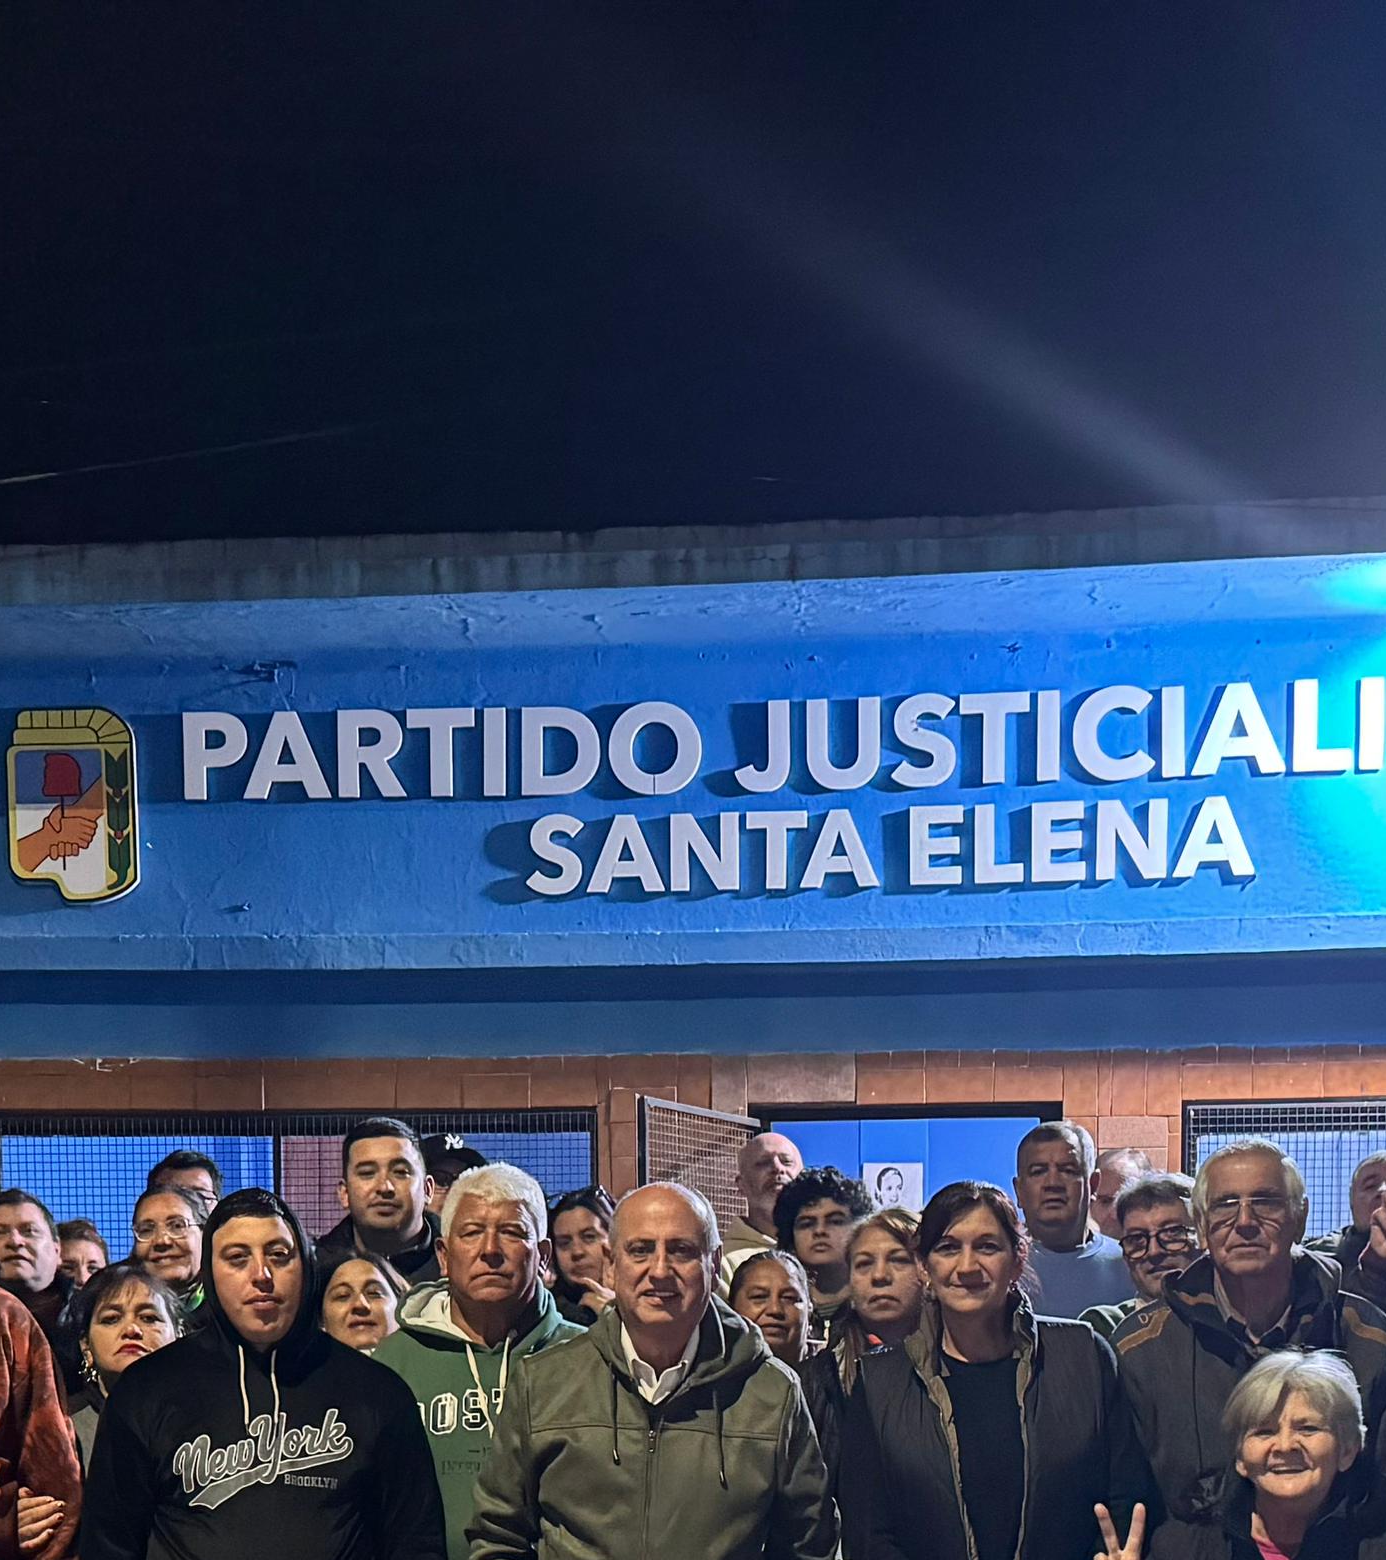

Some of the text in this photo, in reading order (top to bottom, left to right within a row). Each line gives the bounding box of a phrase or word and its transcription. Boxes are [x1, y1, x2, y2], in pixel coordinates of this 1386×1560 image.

[181, 700, 703, 800] PARTIDO
[525, 795, 1255, 896] SANTA ELENA
[173, 1408, 350, 1494] New York
[284, 1473, 338, 1490] BROOKLYN
